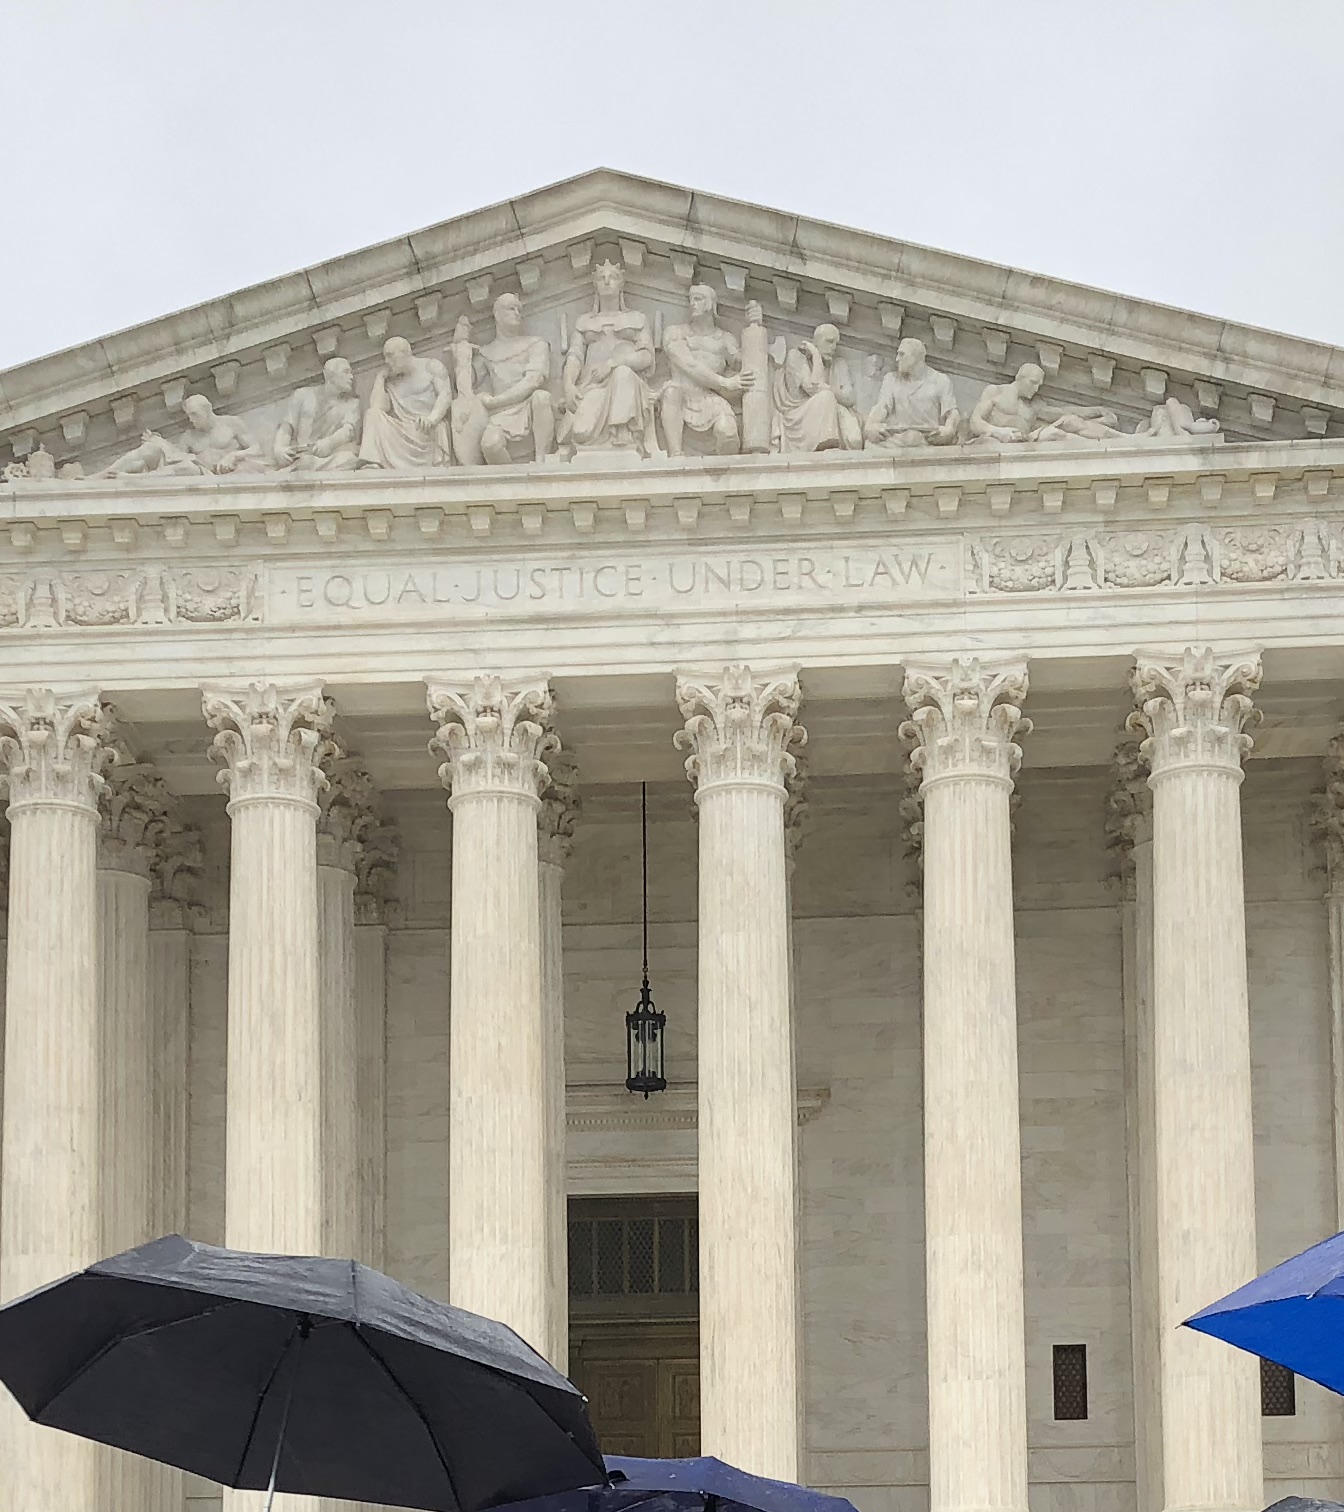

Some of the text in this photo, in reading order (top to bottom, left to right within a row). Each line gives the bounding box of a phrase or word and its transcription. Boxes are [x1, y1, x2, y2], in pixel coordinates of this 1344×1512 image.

[296, 552, 936, 608] EQUAL JUSTICE UNDER LAW
